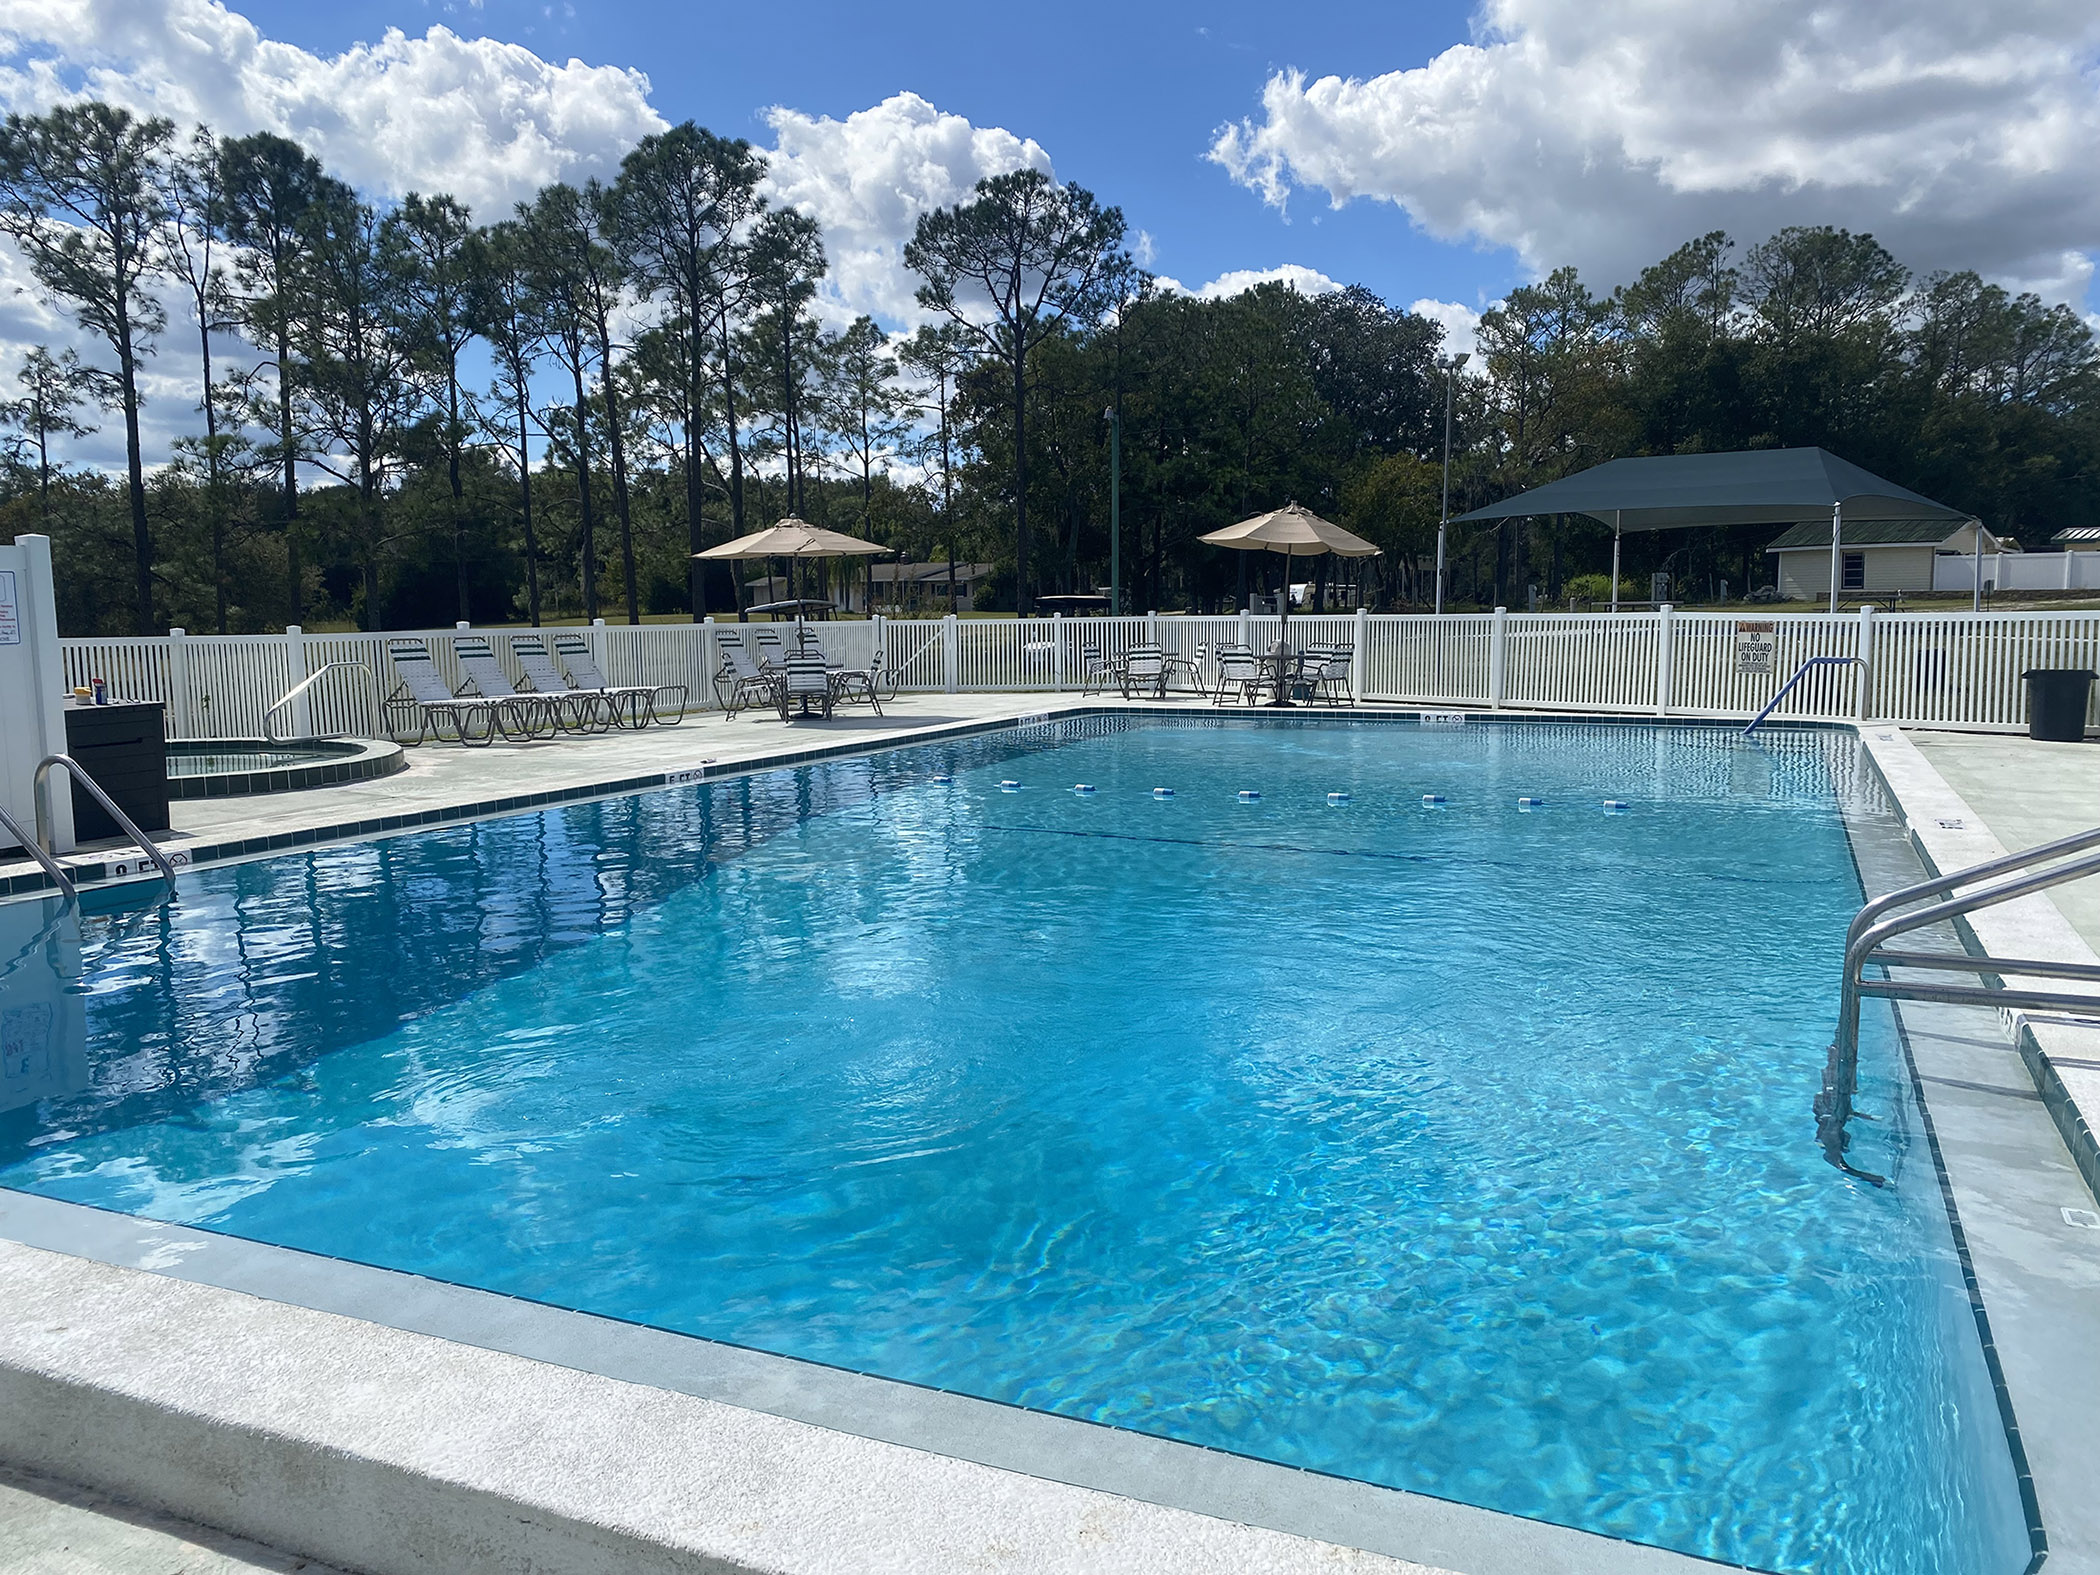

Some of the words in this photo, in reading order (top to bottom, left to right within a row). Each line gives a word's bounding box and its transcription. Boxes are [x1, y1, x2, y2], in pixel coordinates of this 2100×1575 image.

[1747, 623, 1773, 632] WARNING
[1750, 633, 1760, 642] NO
[1738, 643, 1772, 652] LIFEGUARD
[1741, 653, 1750, 661] ON
[1752, 653, 1769, 661] DUTY
